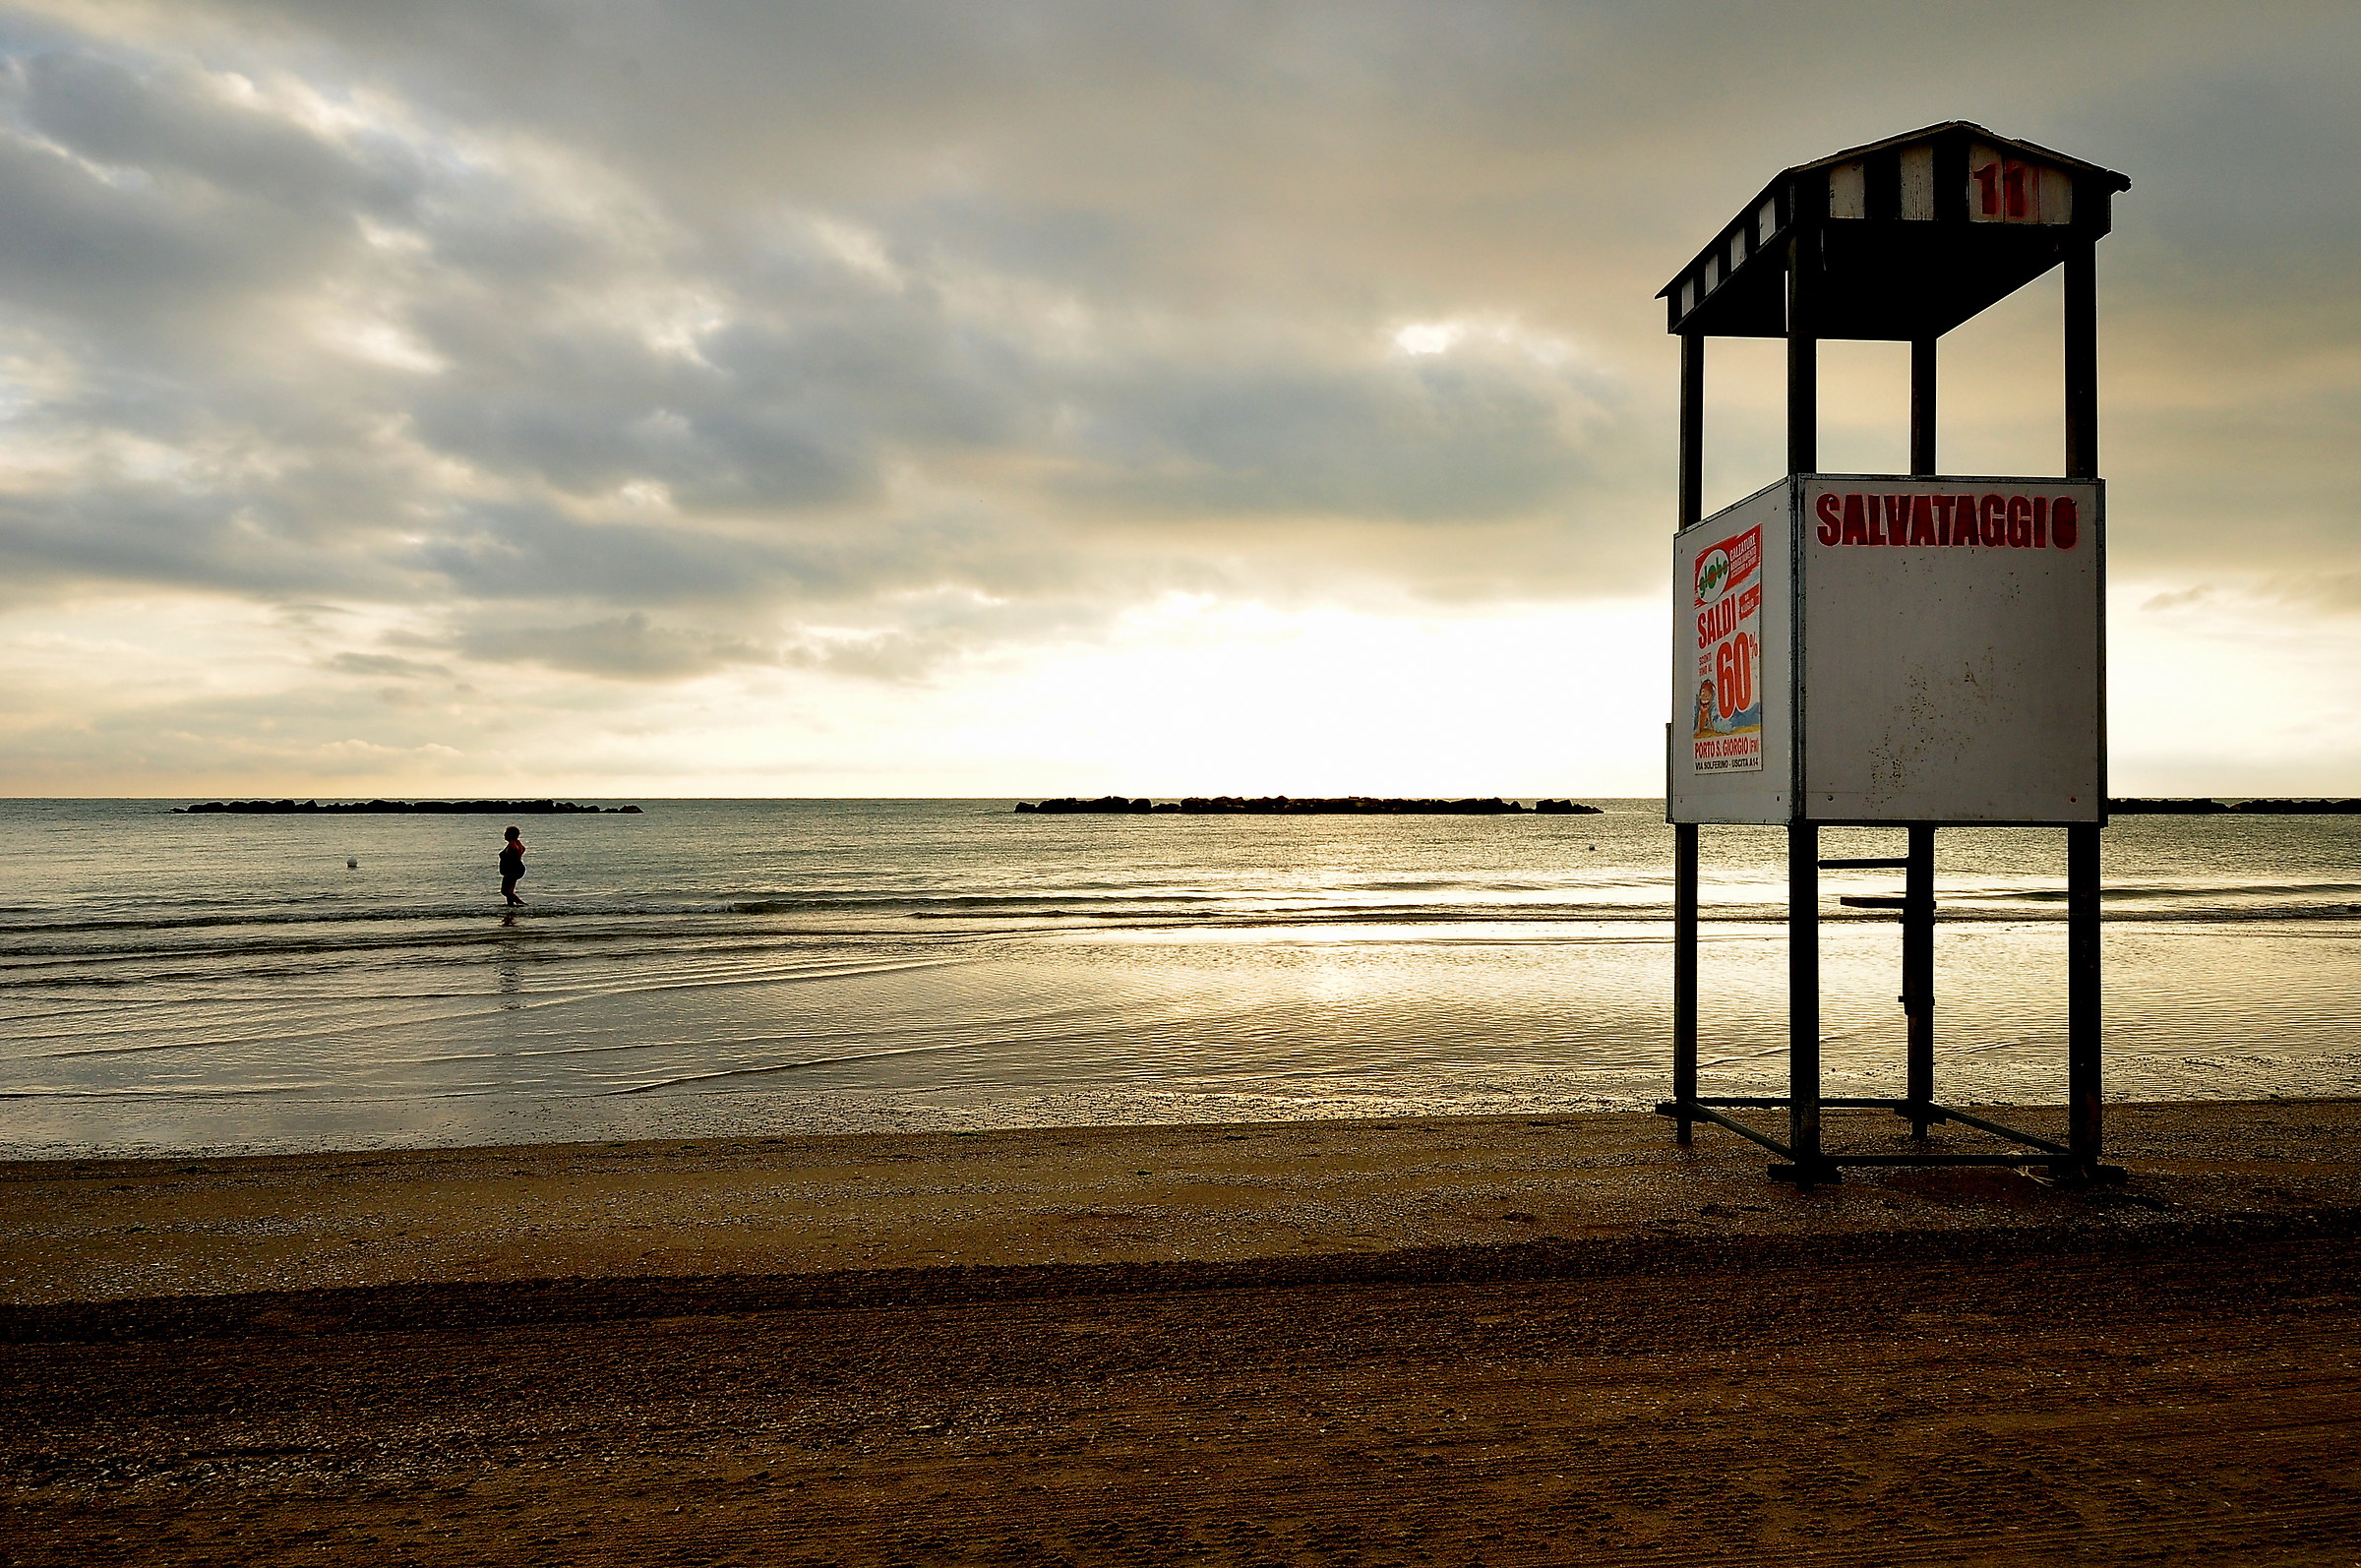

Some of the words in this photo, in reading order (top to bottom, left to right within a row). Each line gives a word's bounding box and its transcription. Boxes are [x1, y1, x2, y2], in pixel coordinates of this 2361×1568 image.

[1973, 162, 2026, 218] 11
[1816, 493, 2078, 550] SALVATAGGIO
[1698, 593, 1736, 649] SALDI
[1695, 741, 1715, 759] PORTO
[1723, 737, 1748, 756] GIORGIO
[1695, 761, 1704, 770] VIA
[1704, 759, 1729, 770] SOLFERINO
[1731, 757, 1748, 768] USCITA
